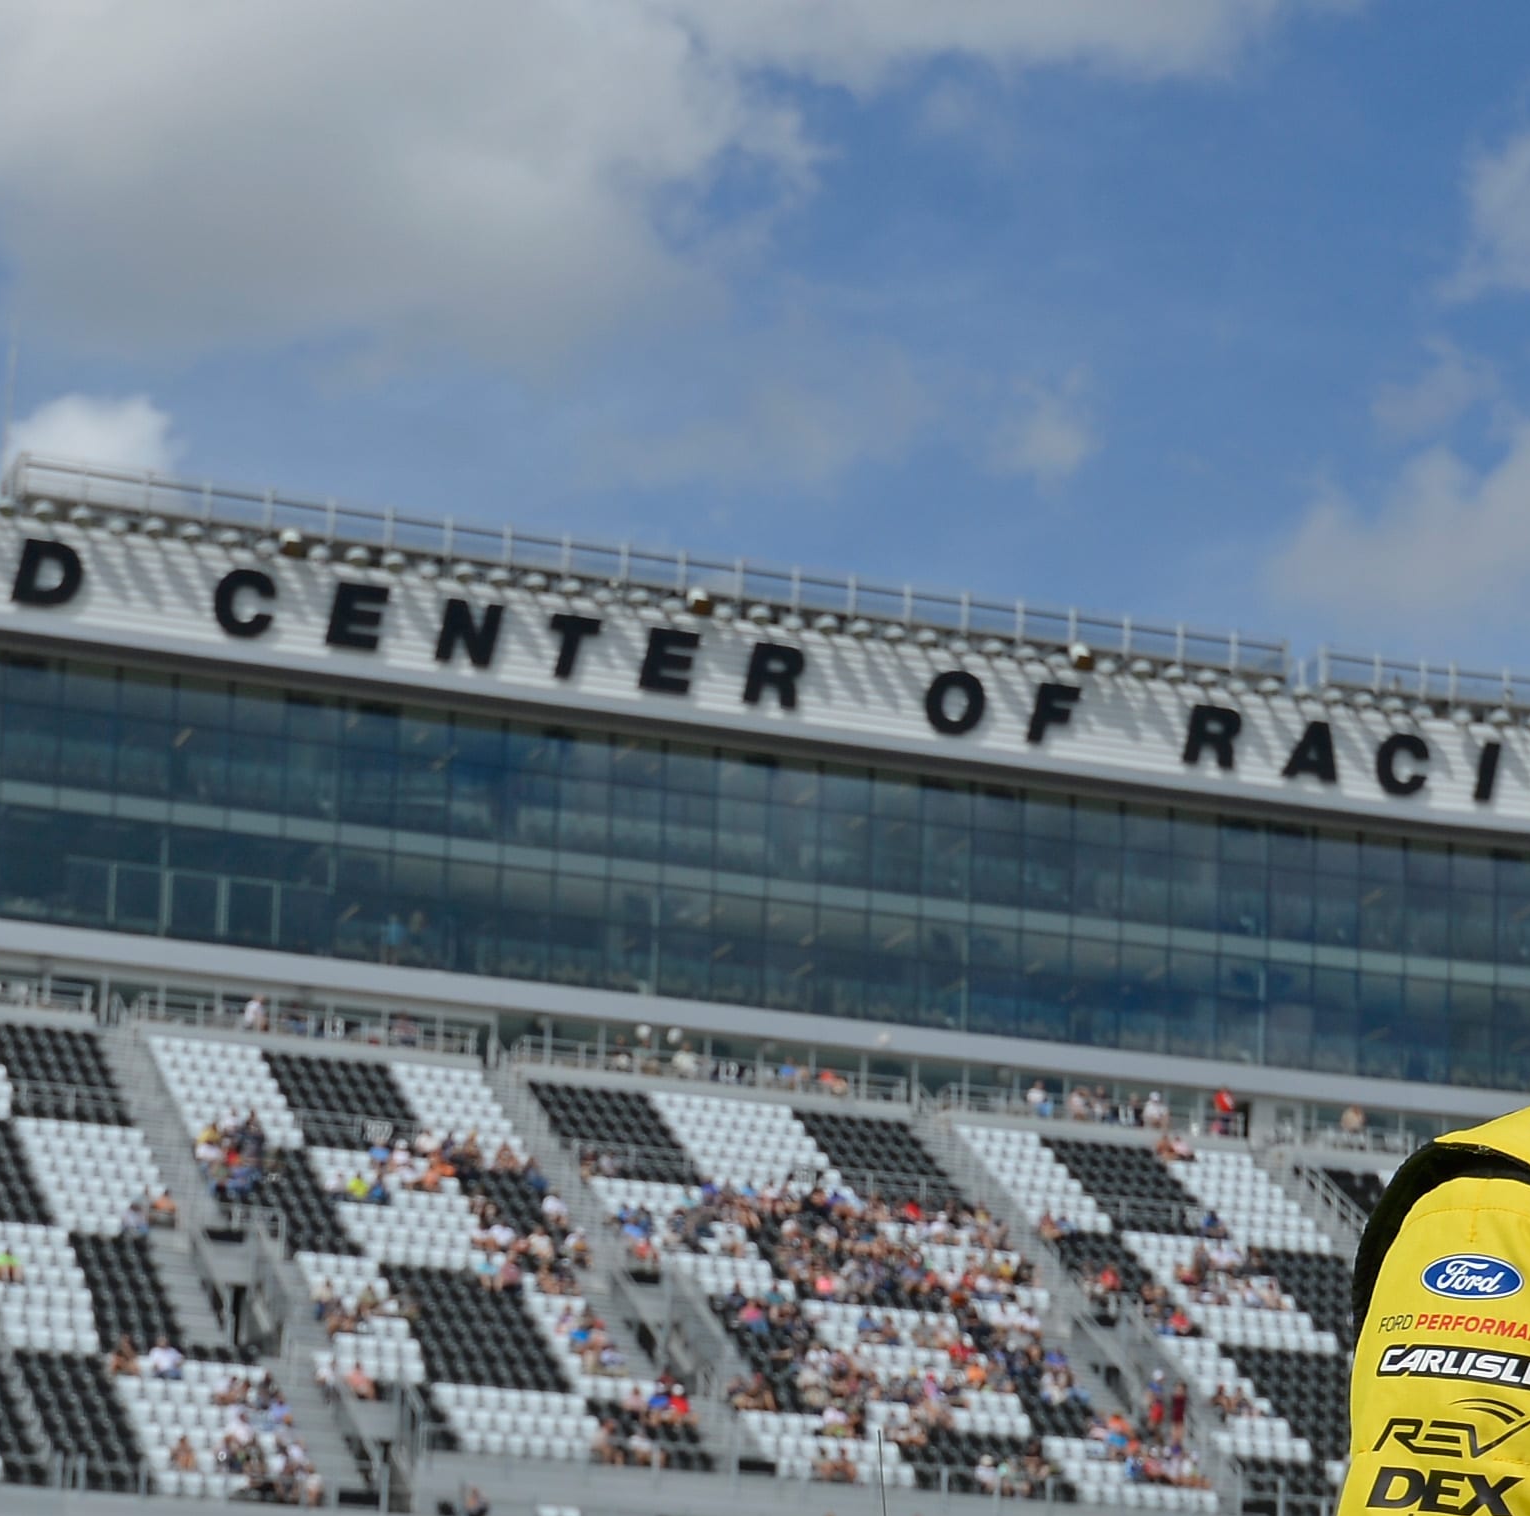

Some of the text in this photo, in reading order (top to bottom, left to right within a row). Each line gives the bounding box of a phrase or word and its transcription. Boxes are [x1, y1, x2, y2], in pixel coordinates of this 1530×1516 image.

[213, 567, 806, 711] CENTER
[924, 668, 1079, 746] OF
[1436, 1257, 1508, 1295] Ford
[1378, 1313, 1414, 1335] FORD
